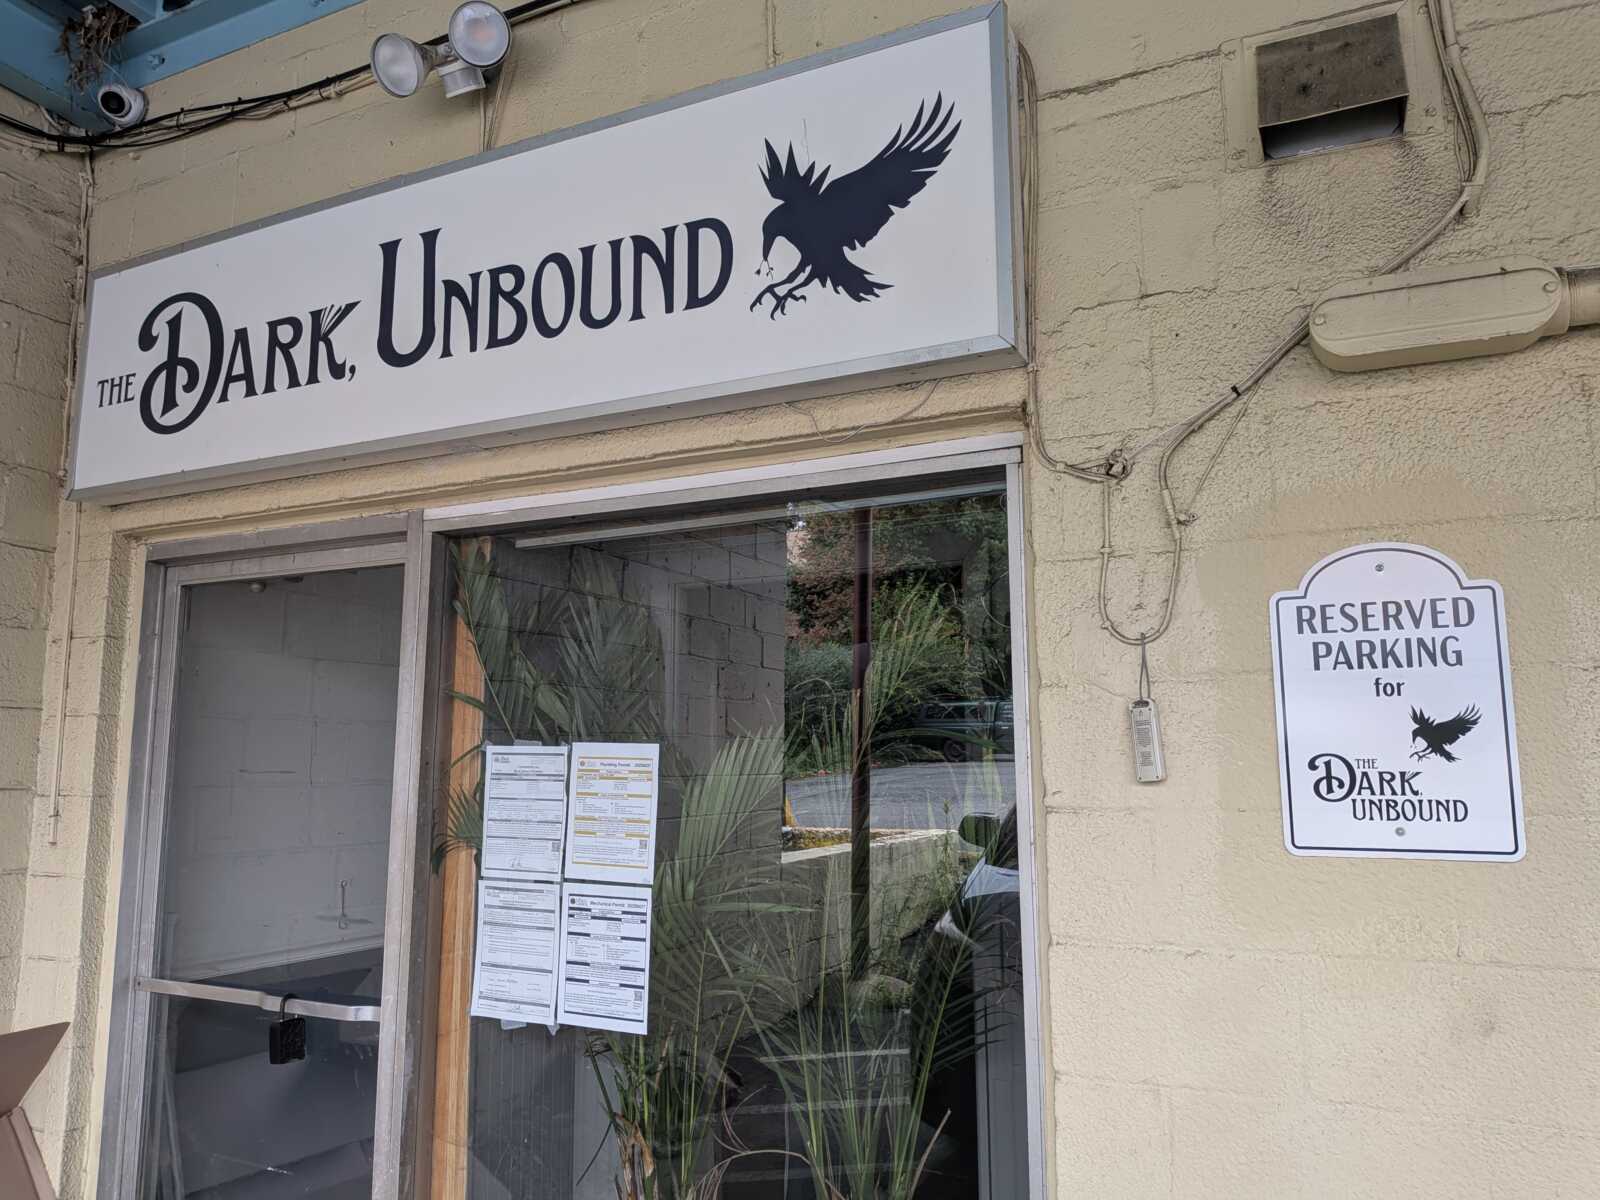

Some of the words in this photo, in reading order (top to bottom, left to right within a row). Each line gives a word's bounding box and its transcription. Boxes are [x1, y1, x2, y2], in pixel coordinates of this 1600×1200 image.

[97, 372, 137, 408] THE
[137, 291, 362, 436] DARK,
[376, 216, 734, 368] UNBOUND
[1295, 596, 1475, 635] RESERVED
[1311, 636, 1464, 671] PARKING
[1373, 677, 1405, 698] for
[1355, 758, 1379, 770] THE
[1351, 798, 1469, 823] UNBOUND
